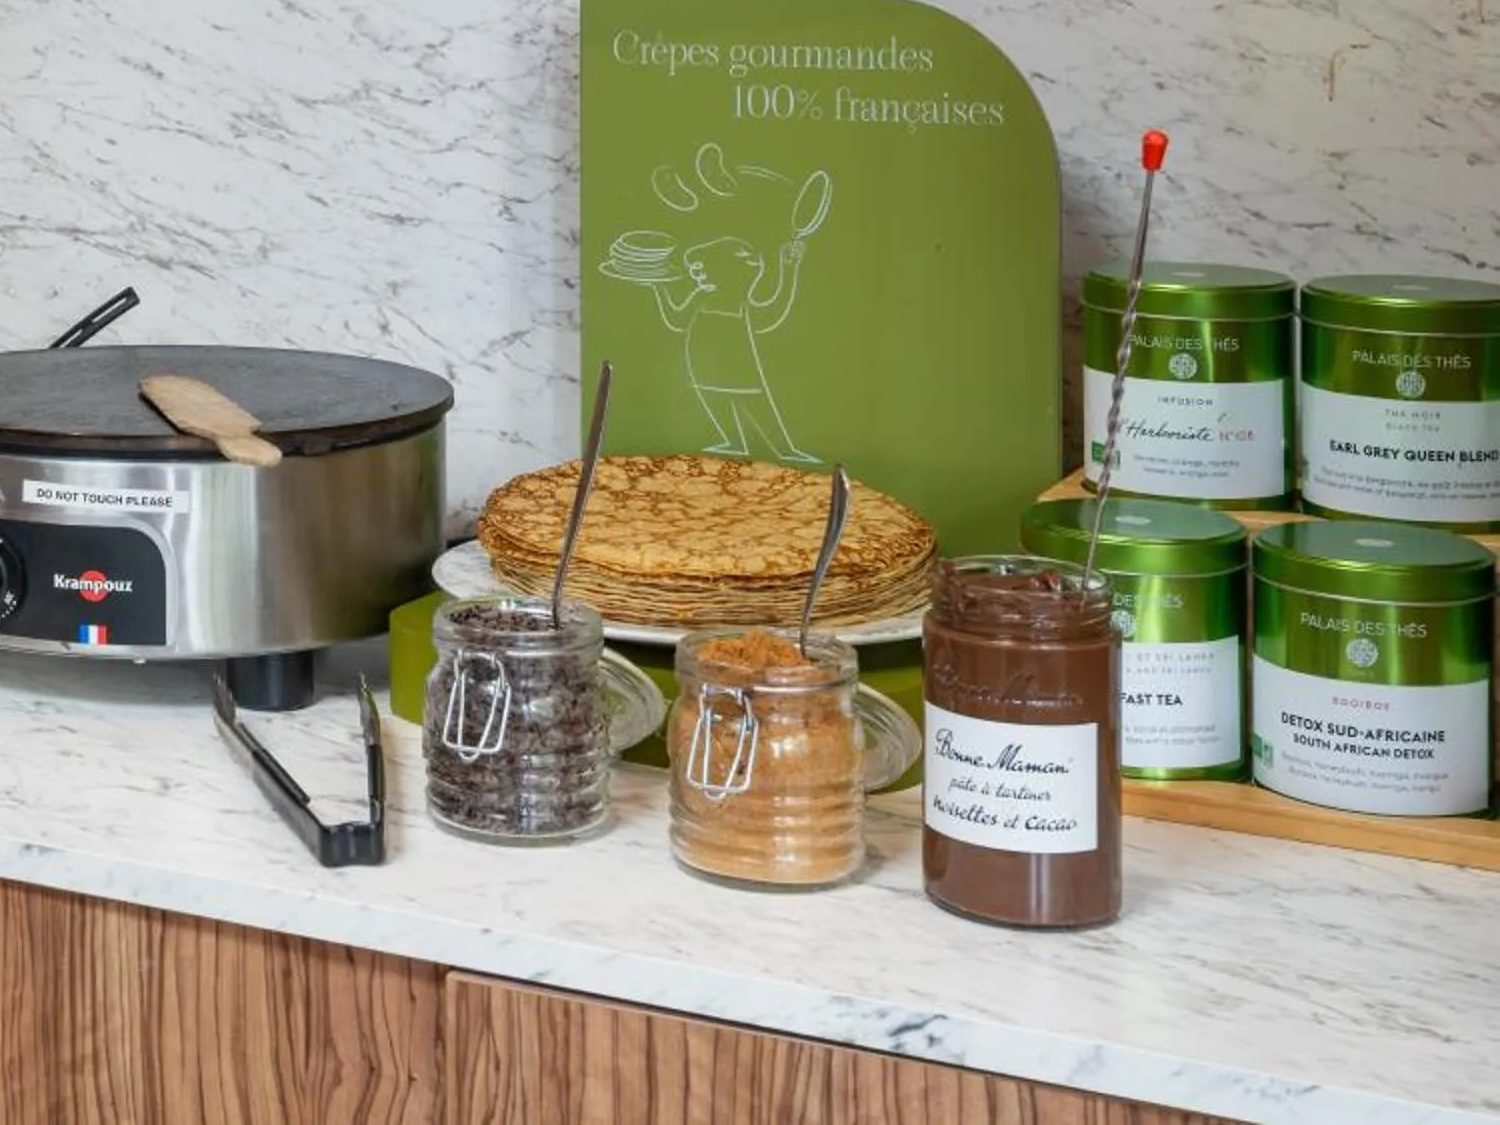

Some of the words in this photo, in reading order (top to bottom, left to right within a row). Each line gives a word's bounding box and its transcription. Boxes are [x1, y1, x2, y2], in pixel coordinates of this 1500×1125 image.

[612, 28, 720, 76] Crêpes
[728, 34, 934, 78] gourmandes
[734, 82, 824, 121] 100%
[834, 84, 1005, 135] françaises
[1128, 331, 1173, 349] PALAIS
[1175, 338, 1202, 350] DES
[1206, 335, 1241, 352] HÉS
[1352, 350, 1400, 367] PALAIS
[1403, 354, 1431, 368] DES
[1157, 395, 1214, 407] INFUSION
[1329, 439, 1361, 455] EARL
[1363, 445, 1400, 459] GREY
[1404, 450, 1455, 463] QUEEN
[1459, 449, 1499, 463] BLEND
[37, 488, 53, 499] DO
[56, 491, 79, 503] NOT
[82, 492, 123, 506] TOUCH
[125, 496, 173, 508] PLEASE
[53, 572, 133, 594] Krampouz
[1300, 612, 1350, 633] PALAIS
[1354, 621, 1385, 637] DES
[1387, 622, 1427, 640] HÉS
[1156, 694, 1183, 707] TEA
[1281, 711, 1323, 733] DETOX
[1327, 722, 1445, 744] SUD-AFRICAINE
[934, 728, 985, 768] Bonne
[987, 743, 1069, 775] Maman
[1293, 733, 1331, 751] SOUTH
[1333, 743, 1391, 759] AFRICAN
[1393, 748, 1435, 760] DETOX
[995, 784, 1052, 802] tartiner
[1003, 814, 1019, 829] et
